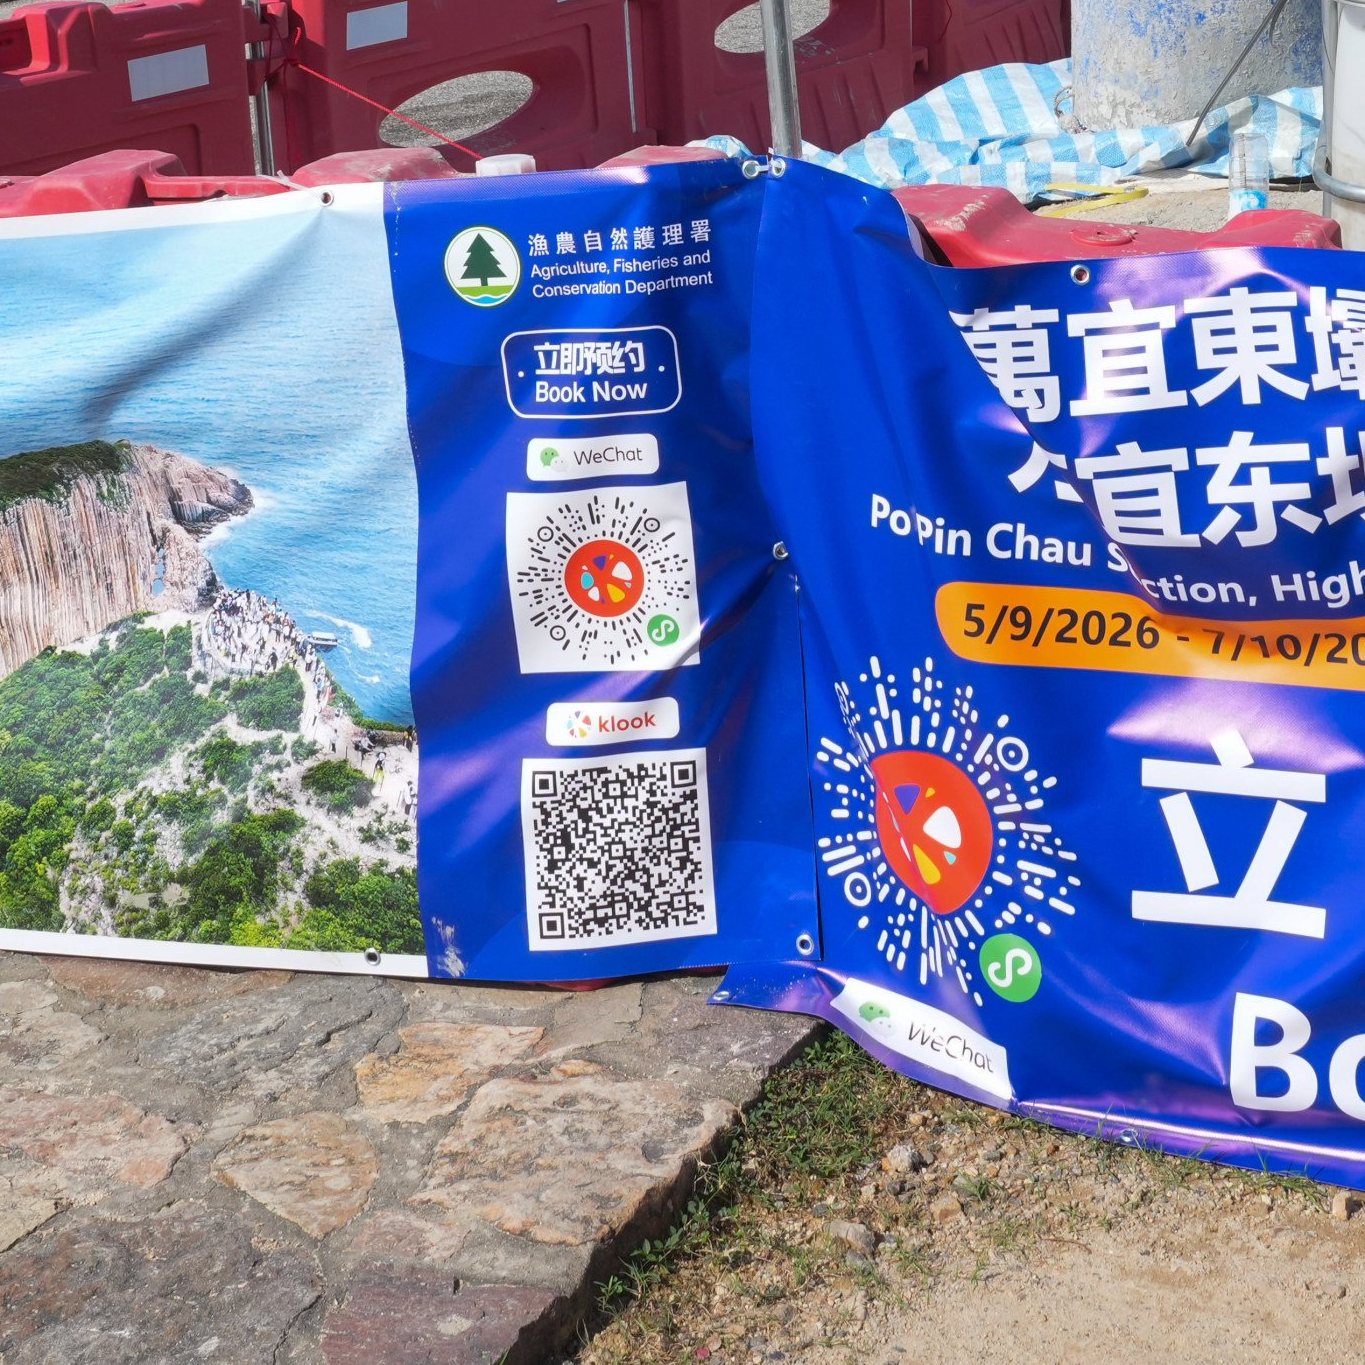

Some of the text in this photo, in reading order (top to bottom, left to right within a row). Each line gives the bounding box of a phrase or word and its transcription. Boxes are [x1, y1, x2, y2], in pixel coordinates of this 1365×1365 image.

[528, 219, 711, 256] 漁農自然護理署
[531, 250, 711, 280] Agriculture, Fisheries and
[533, 271, 712, 298] Conservation Department
[534, 340, 645, 375] 立即预约
[536, 380, 648, 403] Book Now
[574, 446, 642, 466] WeChat
[871, 494, 911, 536] Po
[915, 517, 971, 556] Pin
[986, 522, 1091, 566] Chau
[1107, 542, 1256, 607] Sction,
[963, 603, 1160, 650] 5/9/2026
[598, 712, 656, 733] klook
[907, 1022, 994, 1073] WeChat
